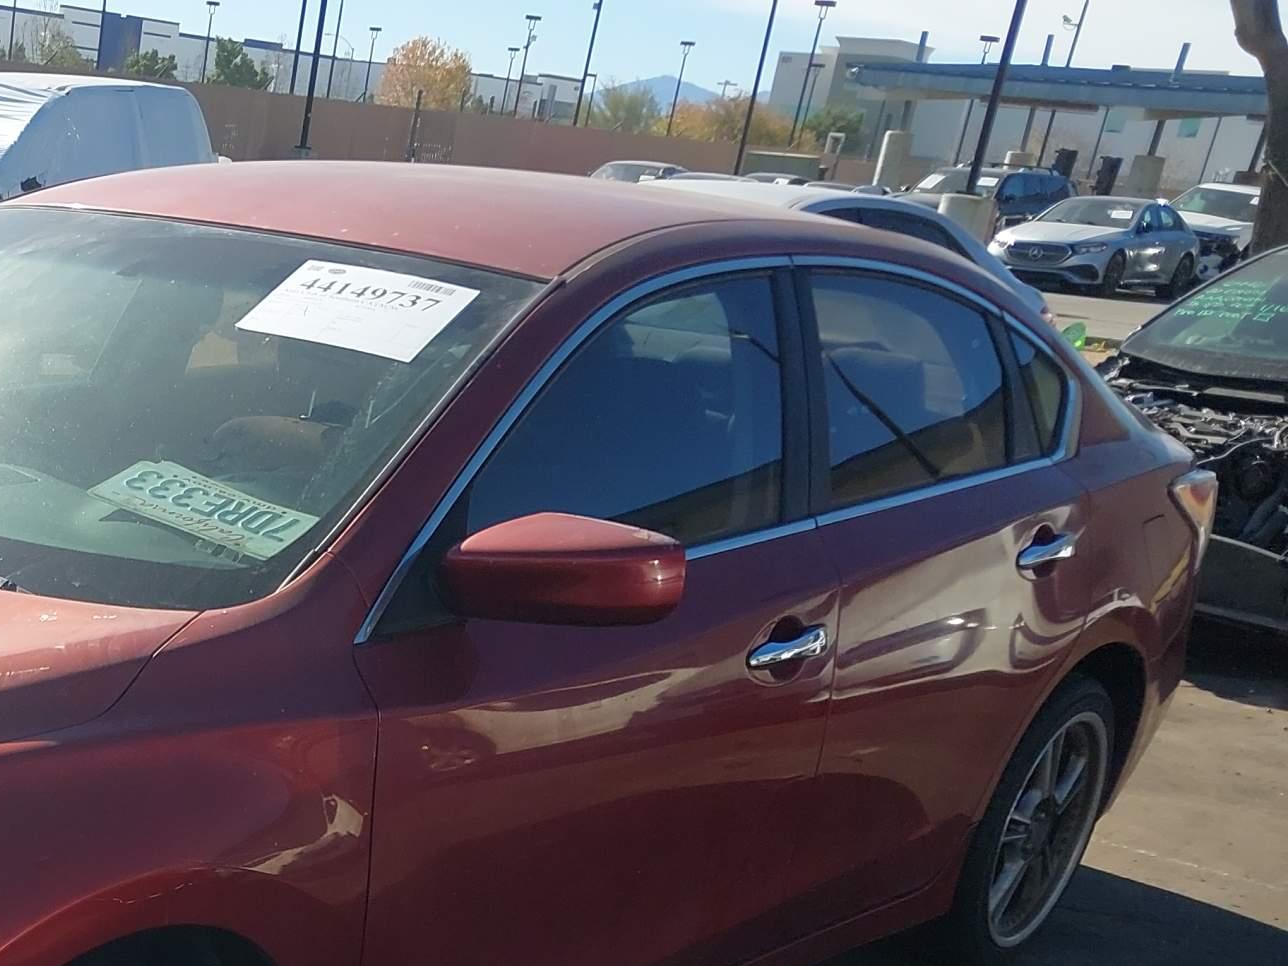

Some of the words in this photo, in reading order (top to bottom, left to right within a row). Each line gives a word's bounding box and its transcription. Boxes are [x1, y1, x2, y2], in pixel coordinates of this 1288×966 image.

[300, 278, 440, 312] 44149737
[124, 470, 300, 542] 7DRE333
[132, 496, 246, 544] California
